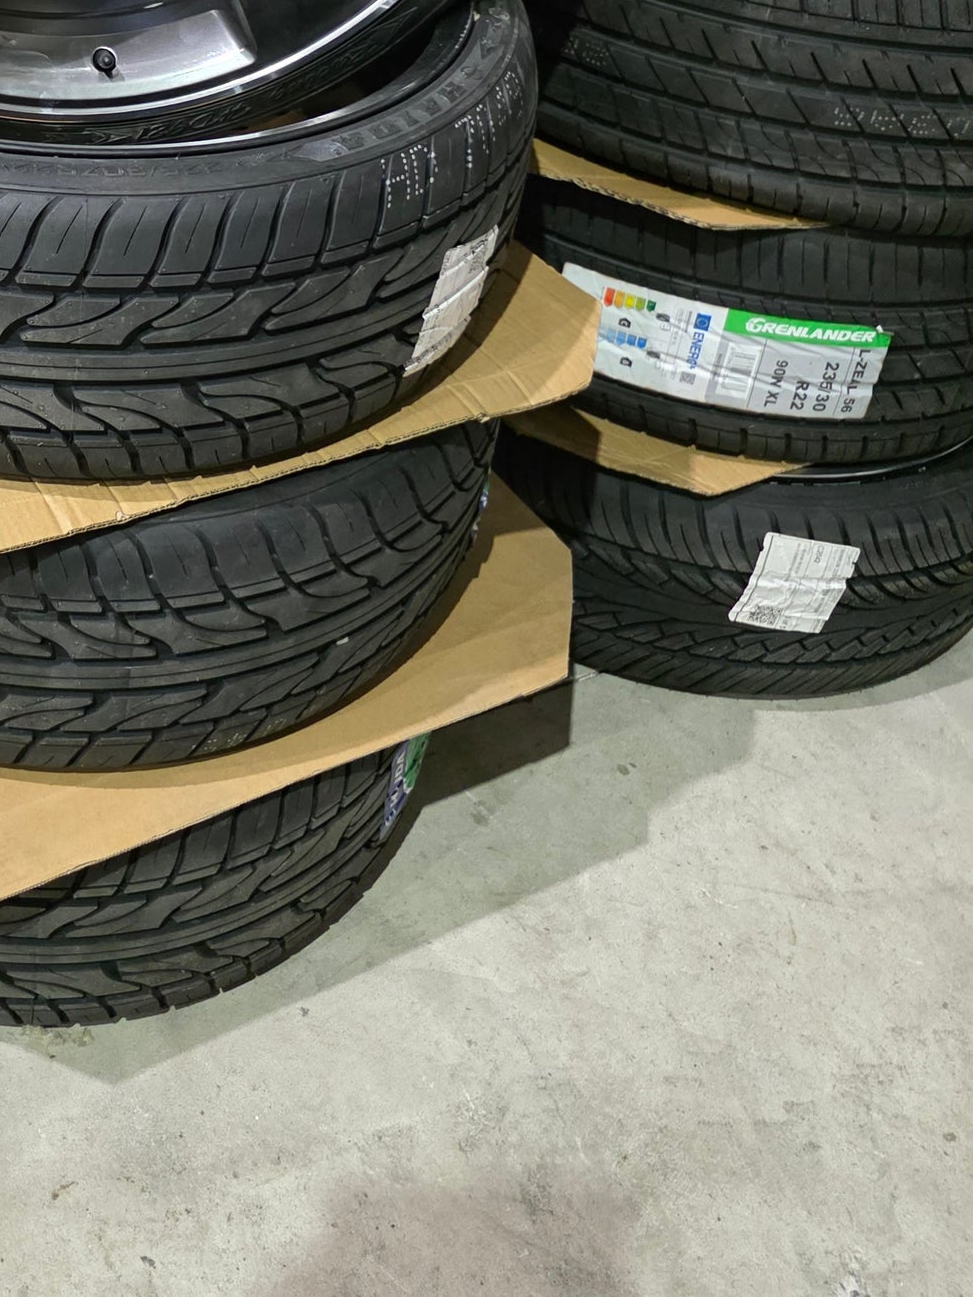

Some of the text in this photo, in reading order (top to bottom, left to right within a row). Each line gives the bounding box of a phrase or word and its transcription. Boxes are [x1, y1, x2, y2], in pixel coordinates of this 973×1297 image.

[745, 316, 877, 343] GRENLANDER
[789, 379, 810, 411] R22
[812, 360, 840, 413] 235/30
[840, 348, 872, 414] L-ZEAL 56
[763, 390, 780, 408] XL
